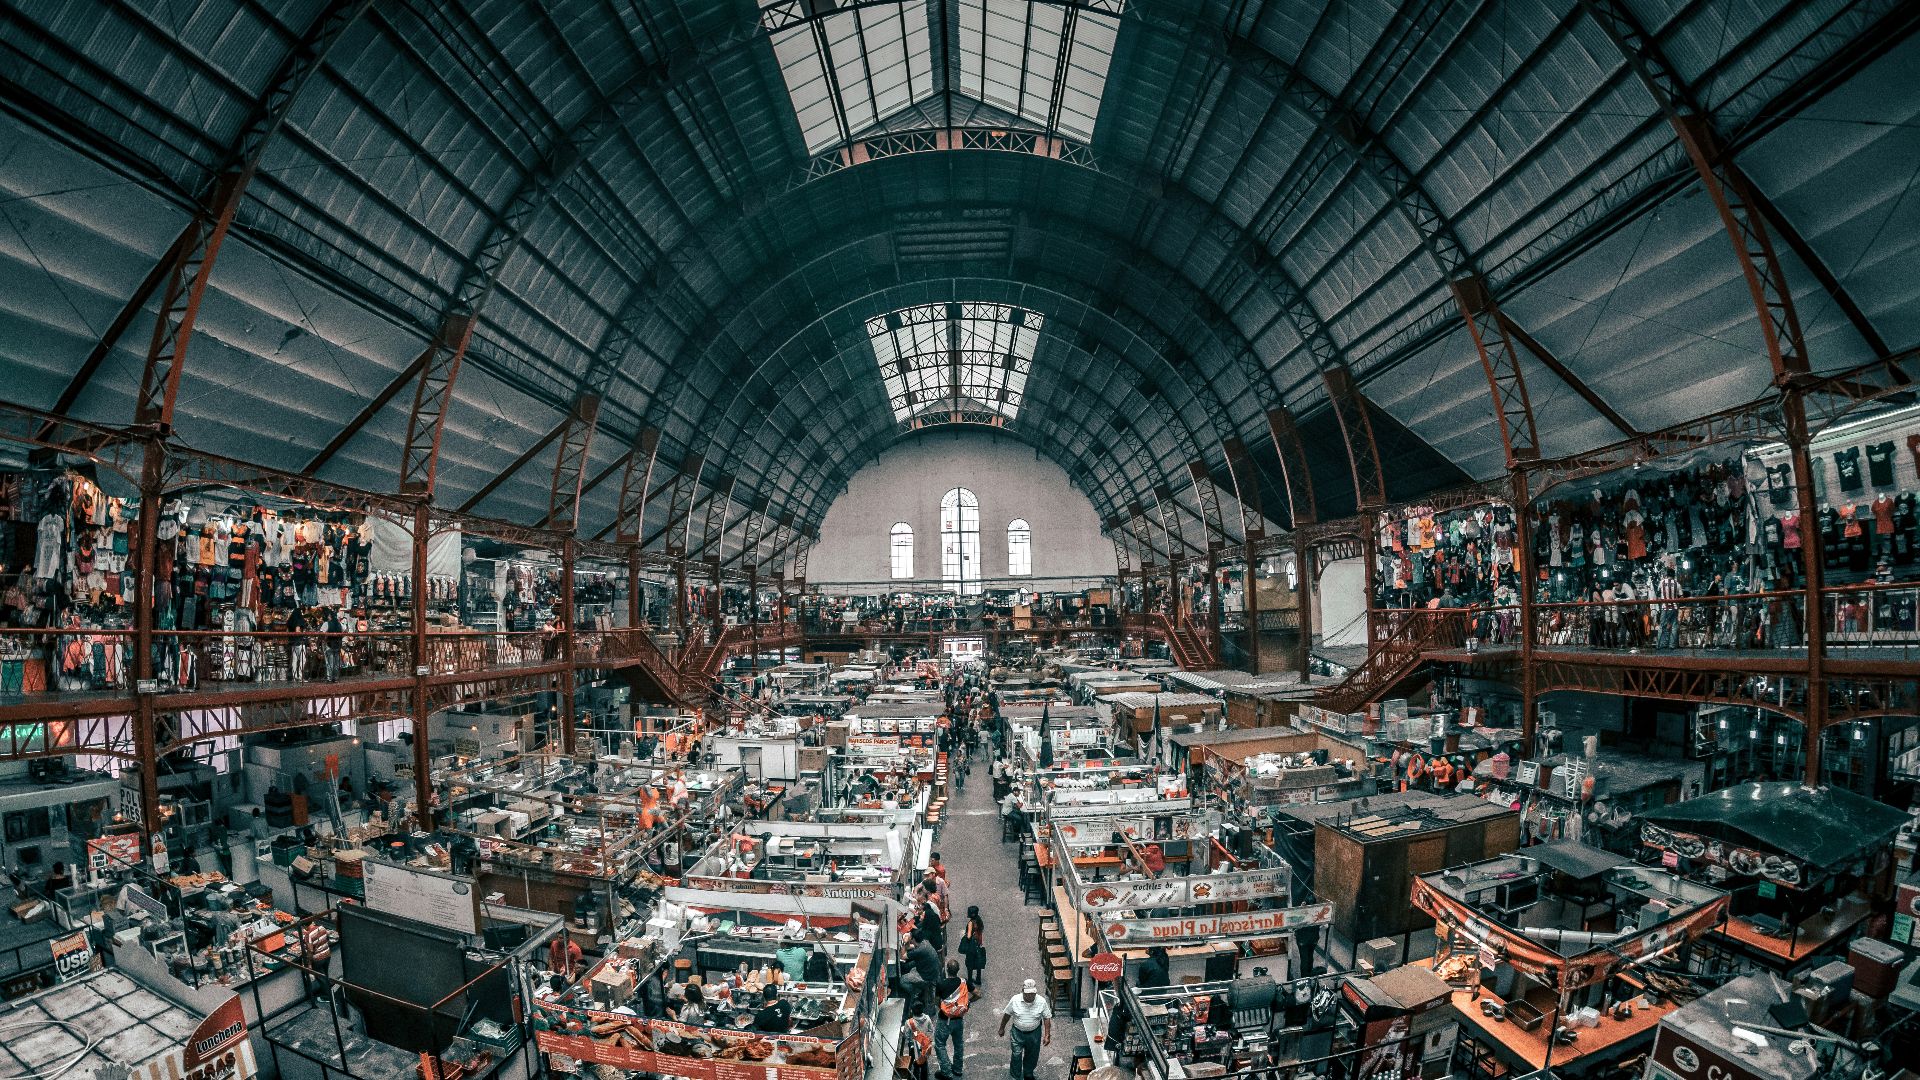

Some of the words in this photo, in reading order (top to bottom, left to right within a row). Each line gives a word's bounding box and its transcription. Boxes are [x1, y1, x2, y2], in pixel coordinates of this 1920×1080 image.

[823, 887, 876, 899] Antojitos
[60, 950, 90, 972] USB
[1089, 962, 1120, 972] Coca-Cola
